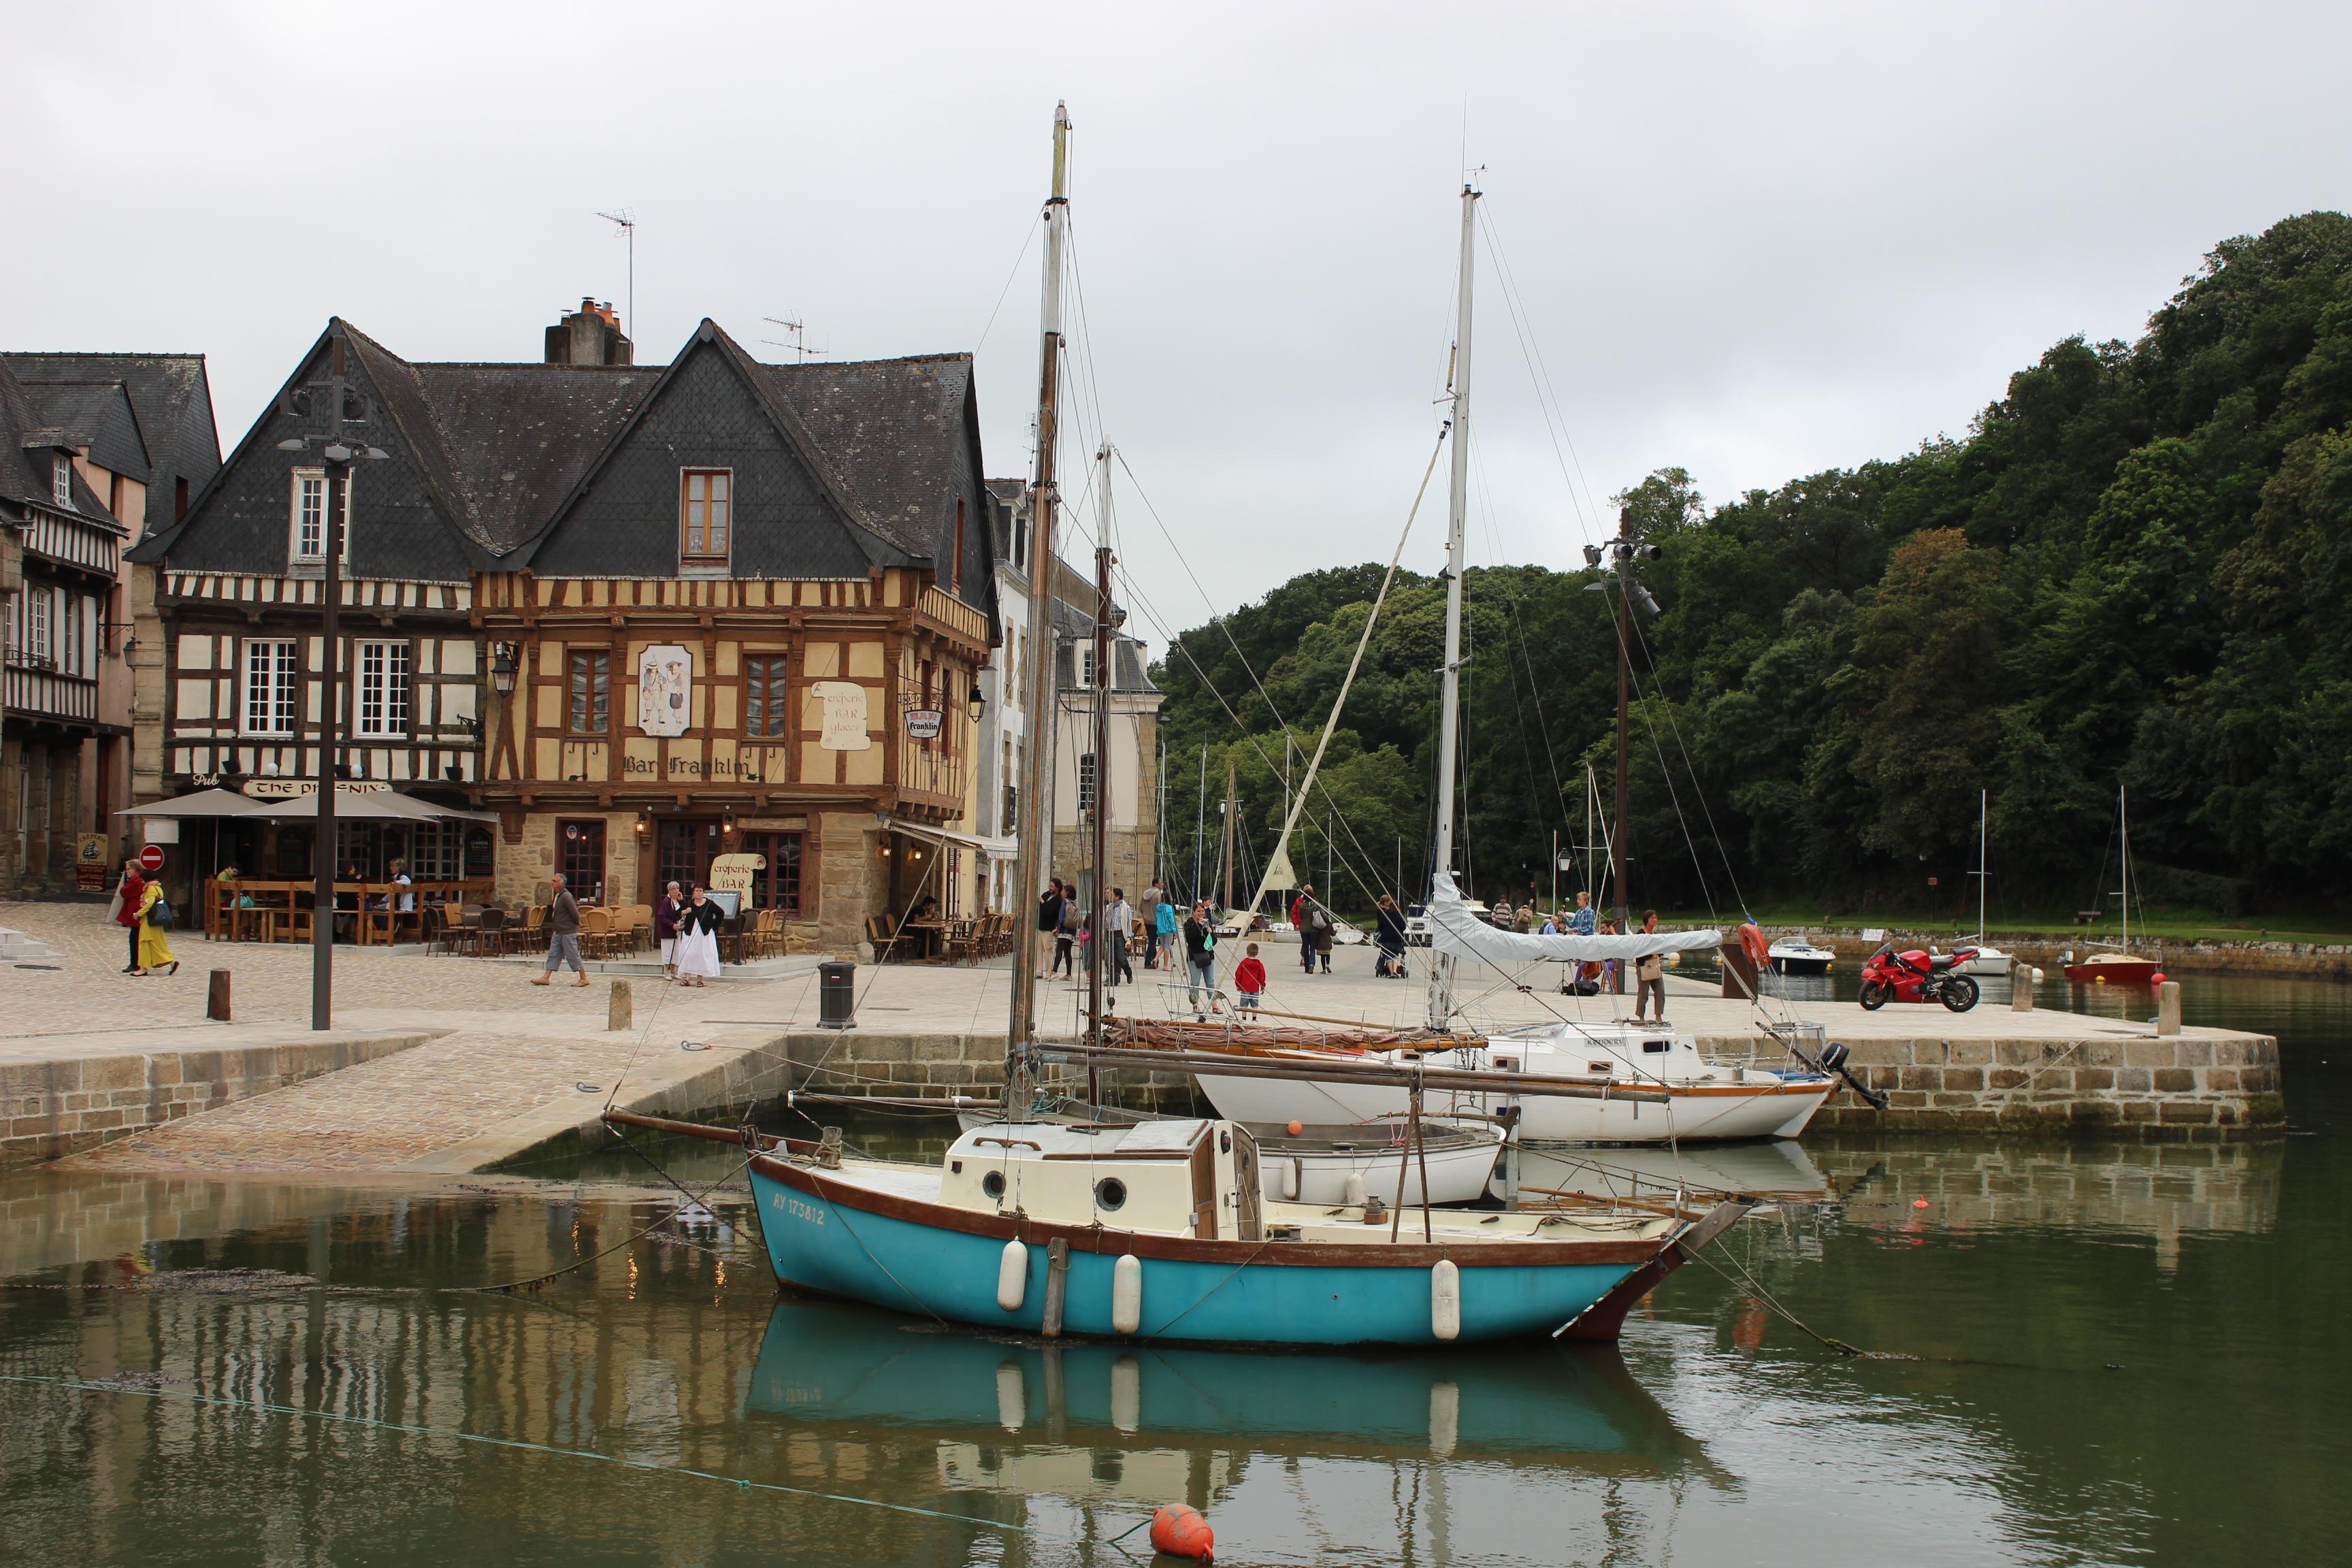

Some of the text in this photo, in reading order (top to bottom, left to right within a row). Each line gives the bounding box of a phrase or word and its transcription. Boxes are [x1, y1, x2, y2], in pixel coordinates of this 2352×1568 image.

[835, 708, 858, 718] BAR
[910, 713, 937, 721] BAR
[625, 755, 750, 774] Bar Franklin
[193, 773, 220, 786] Pub
[722, 879, 745, 889] BAR
[773, 1193, 824, 1225] AY 173812
